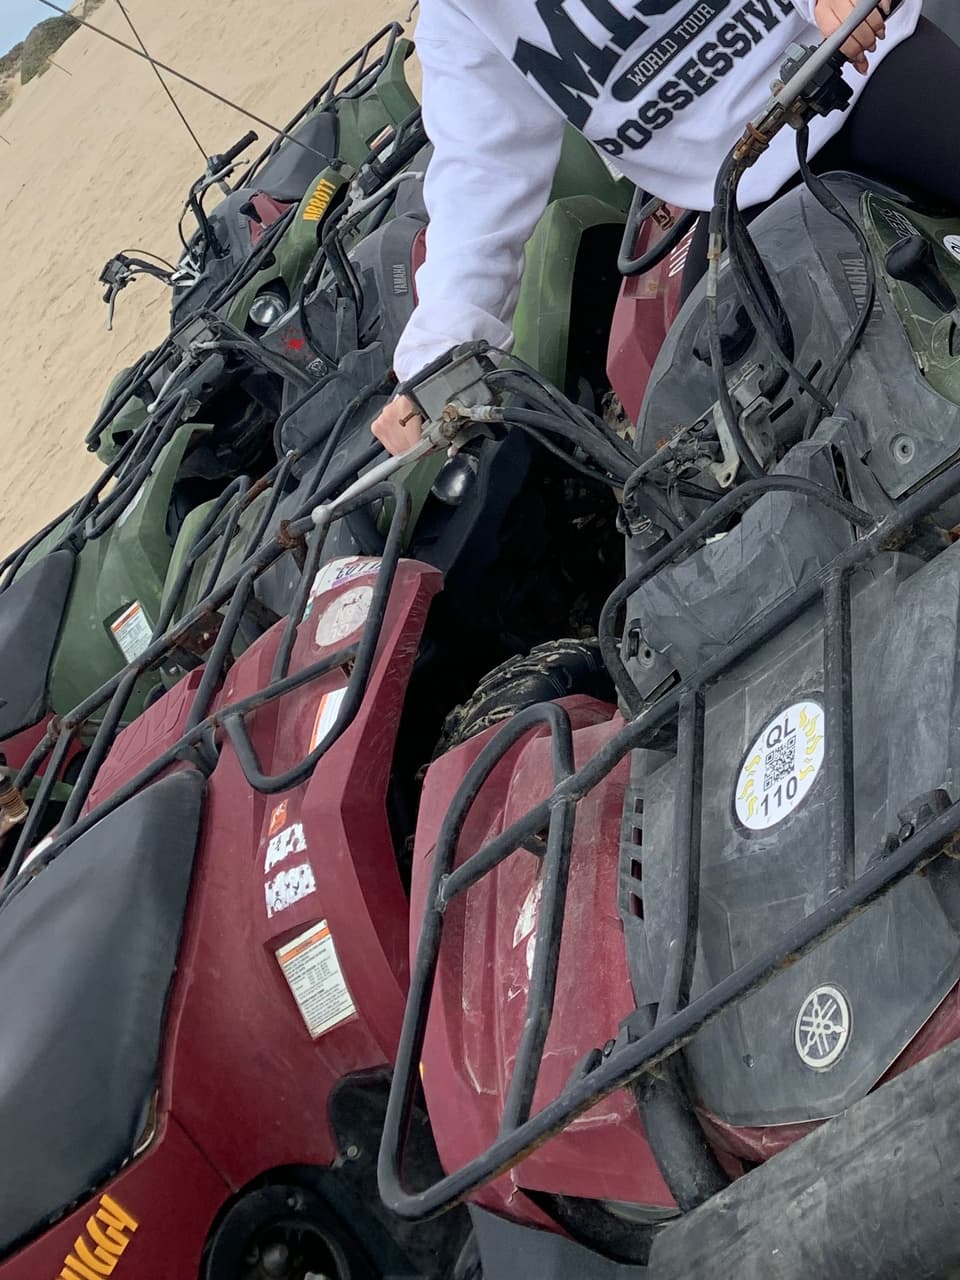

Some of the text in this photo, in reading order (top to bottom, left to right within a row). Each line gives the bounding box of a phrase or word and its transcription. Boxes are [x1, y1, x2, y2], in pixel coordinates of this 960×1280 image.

[627, 2, 716, 87] WORLD TOUR
[303, 178, 336, 222] ABBOTT
[392, 263, 408, 294] YAMAHA
[766, 718, 796, 749] QL
[760, 776, 798, 817] 110
